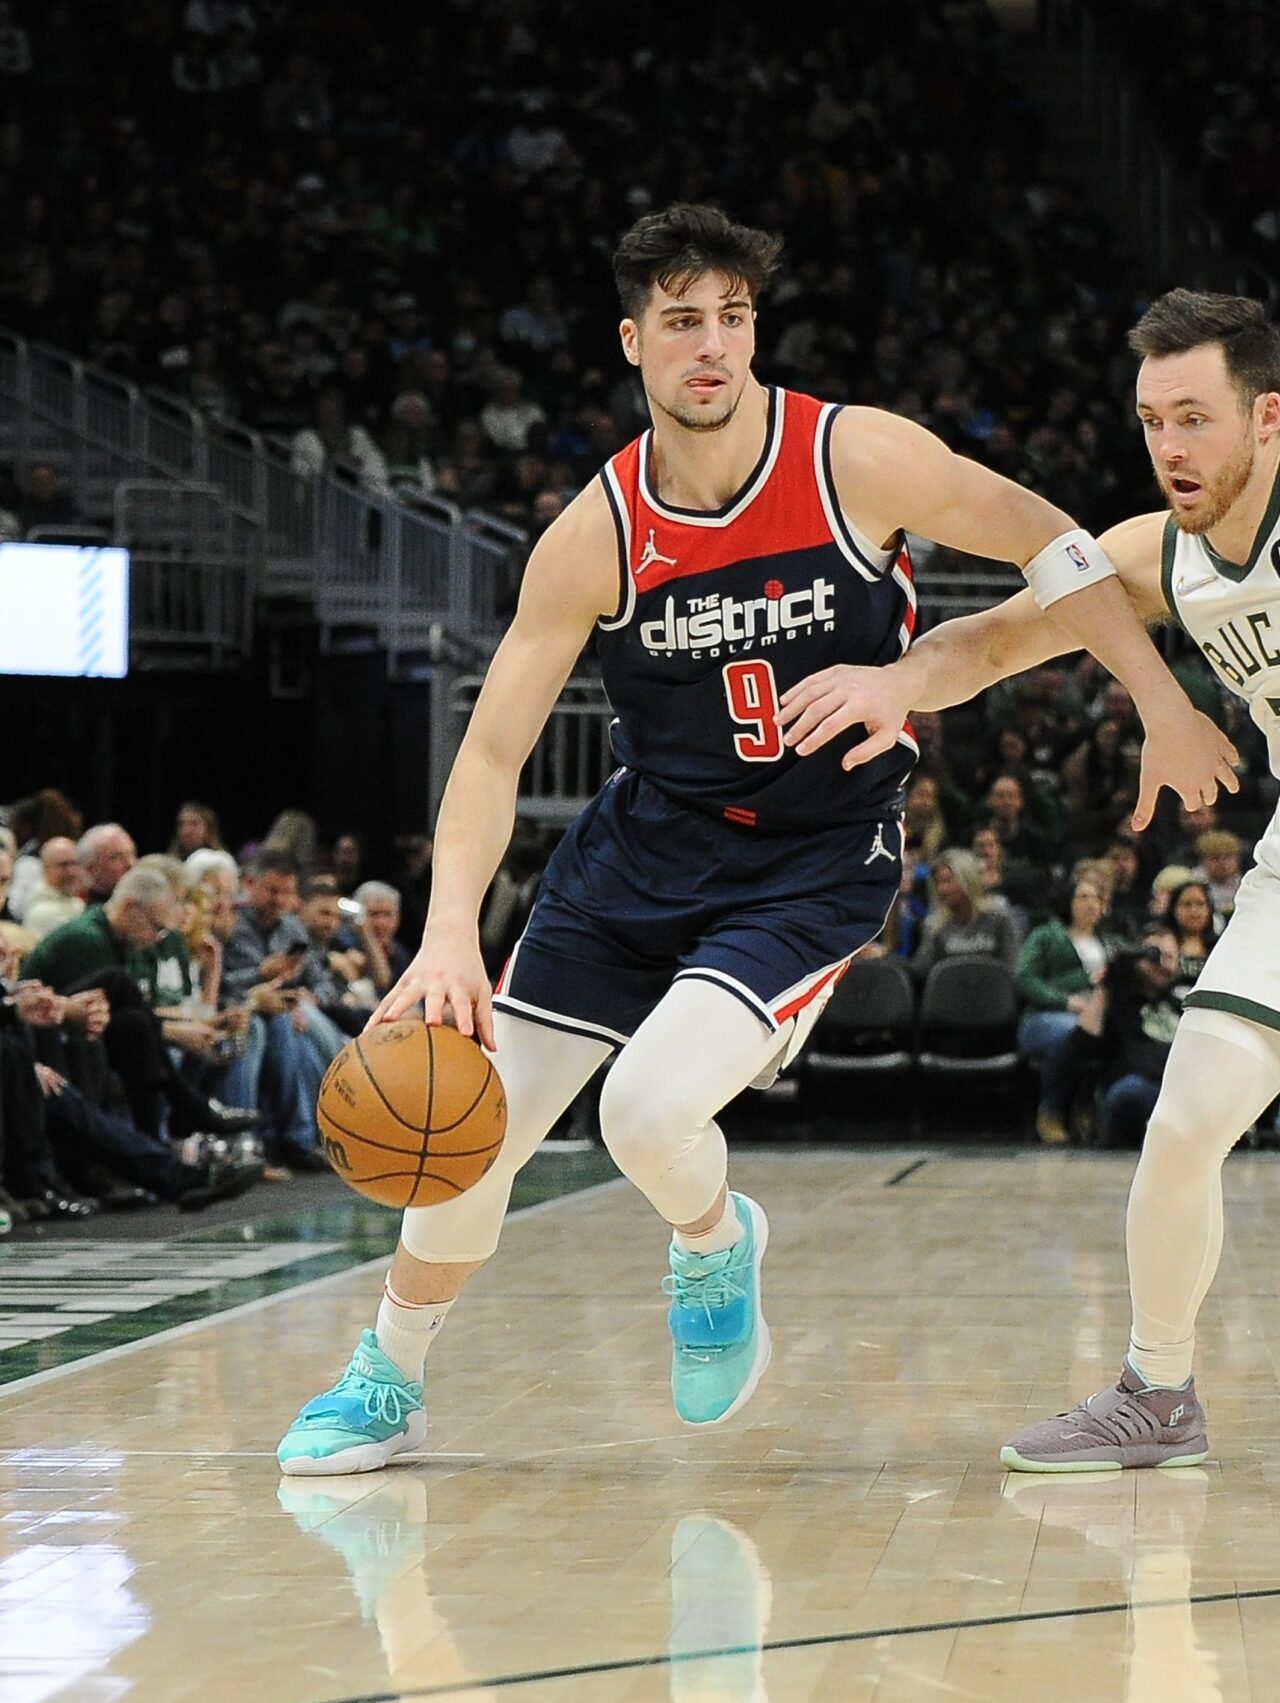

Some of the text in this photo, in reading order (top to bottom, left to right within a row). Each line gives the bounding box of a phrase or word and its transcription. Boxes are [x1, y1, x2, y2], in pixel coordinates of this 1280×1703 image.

[639, 577, 835, 650] district
[687, 593, 720, 613] THE
[692, 620, 835, 659] COLUMBIA
[721, 659, 784, 763] 9
